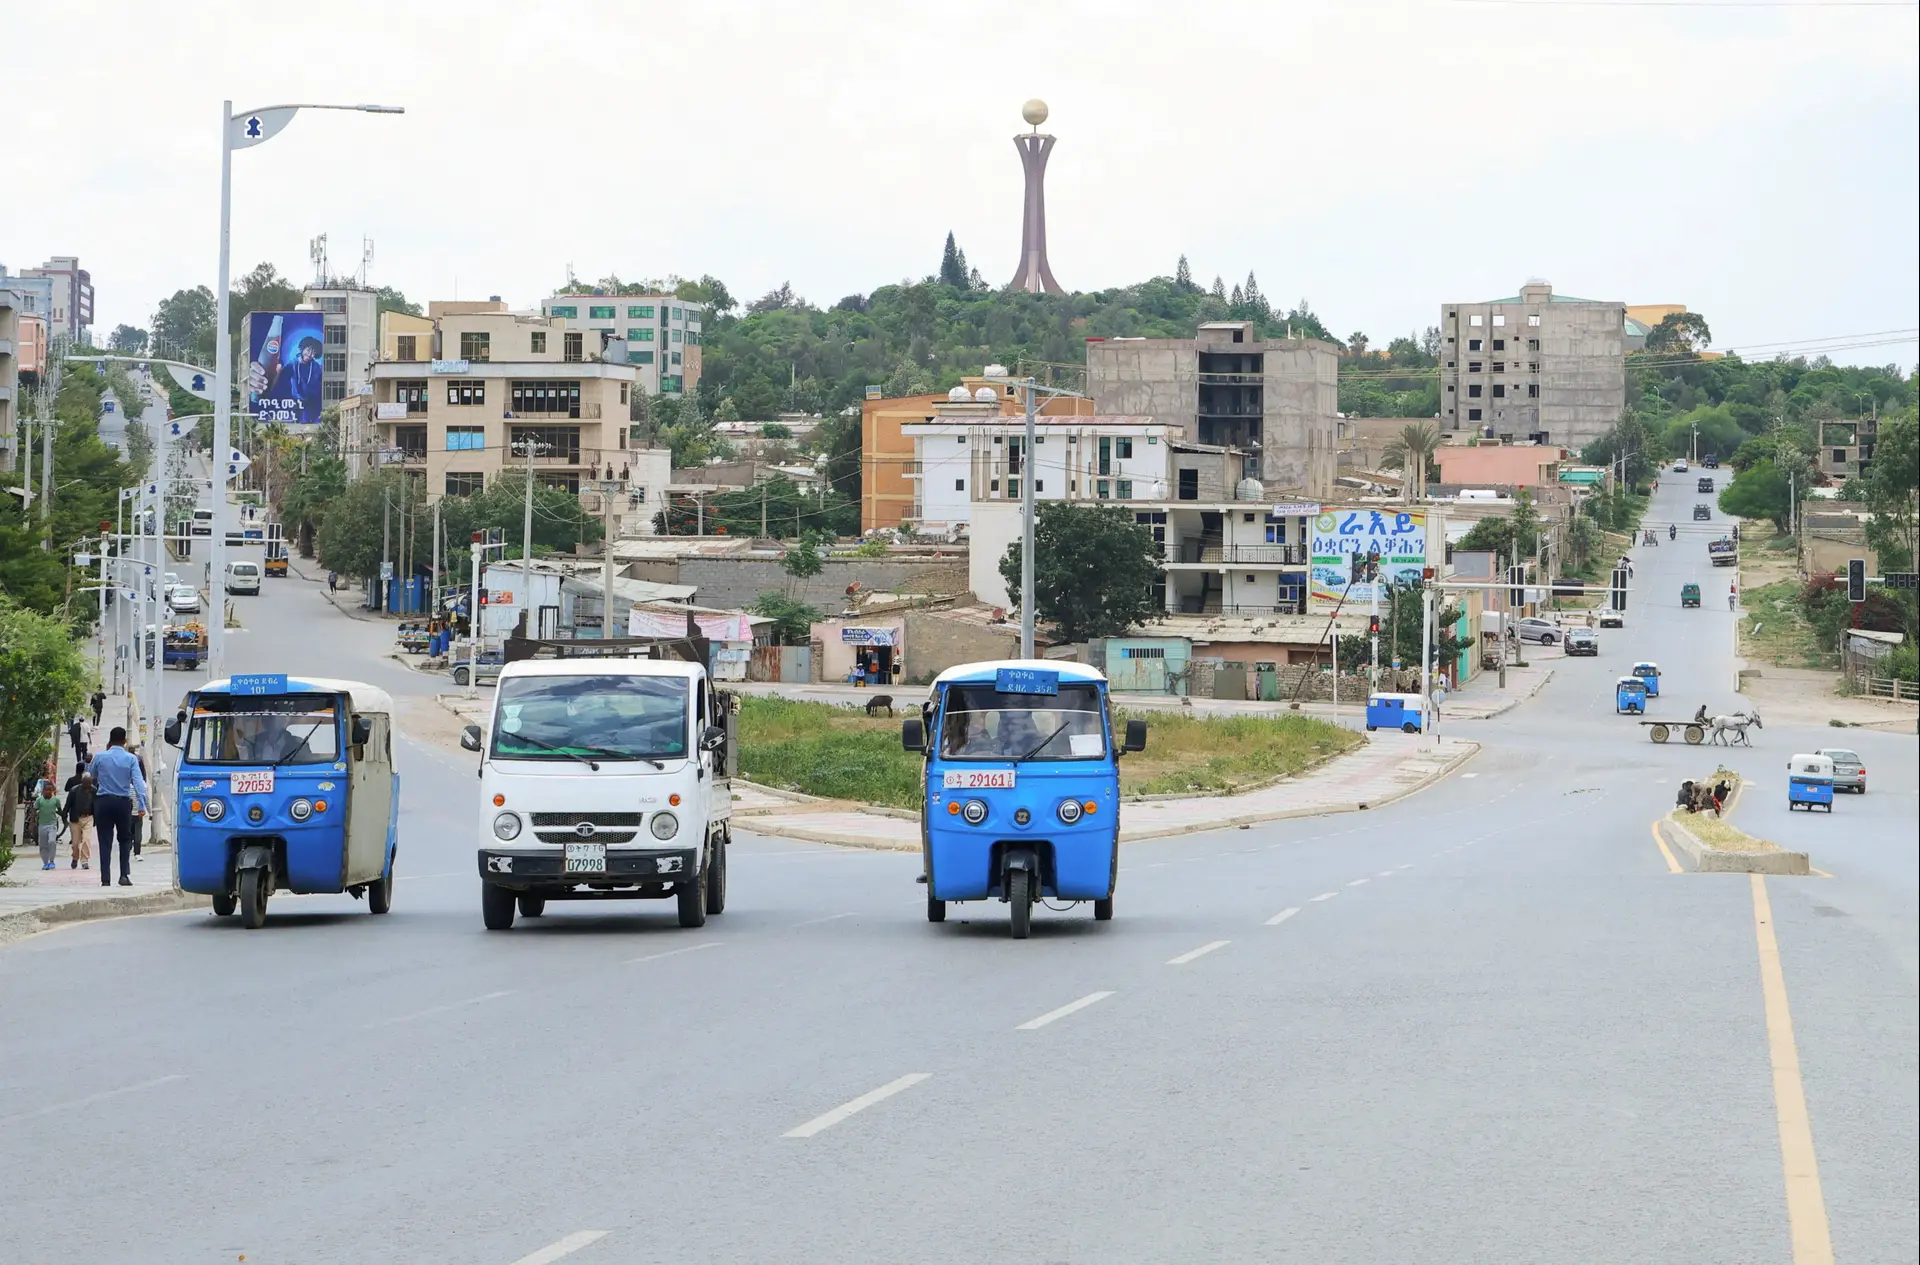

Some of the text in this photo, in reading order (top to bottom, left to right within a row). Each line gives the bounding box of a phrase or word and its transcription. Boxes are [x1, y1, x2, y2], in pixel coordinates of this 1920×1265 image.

[1339, 511, 1416, 536] ራእይ
[250, 685, 266, 695] 101
[237, 780, 272, 793] 27053
[969, 773, 1005, 787] 29161
[567, 858, 603, 871] 07998
